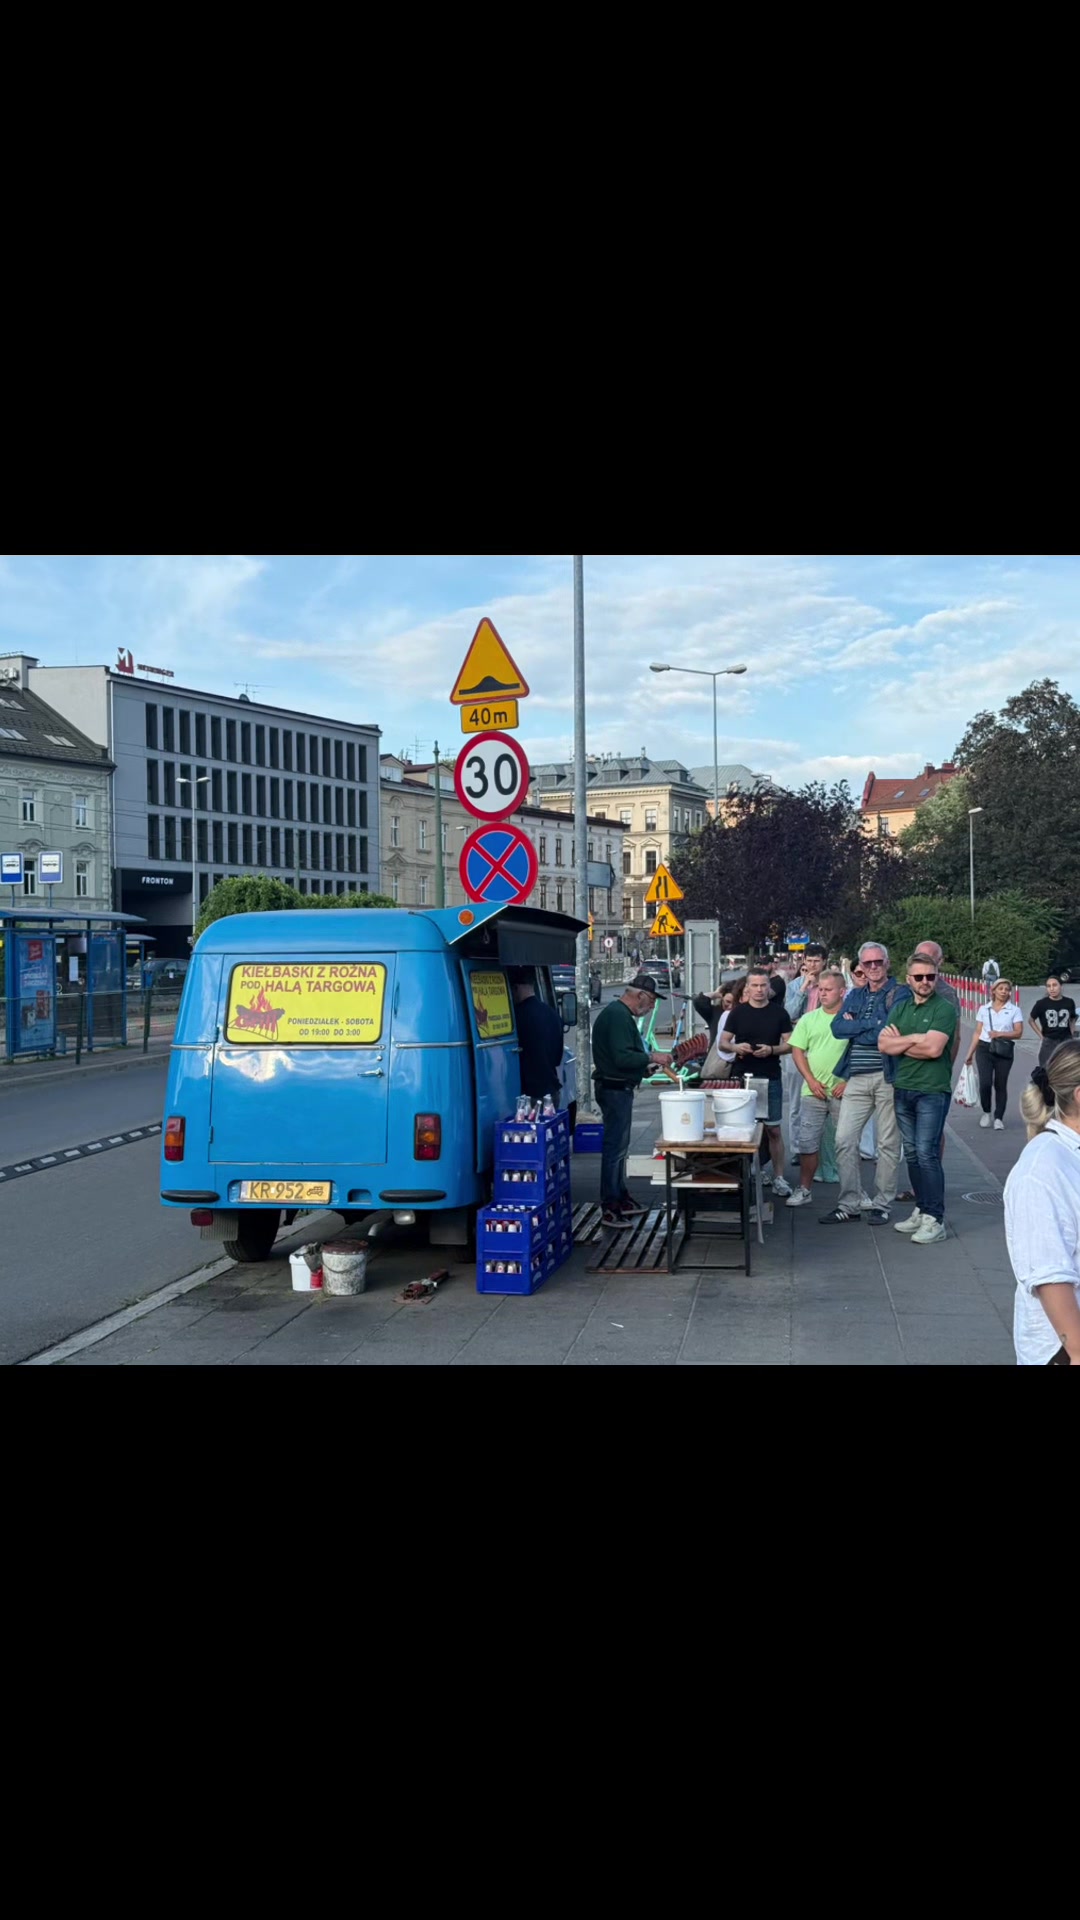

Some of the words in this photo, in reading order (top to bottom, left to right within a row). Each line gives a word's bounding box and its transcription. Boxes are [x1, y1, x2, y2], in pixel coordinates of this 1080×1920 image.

[465, 753, 518, 799] 30
[141, 876, 174, 885] FRONTON
[241, 966, 314, 978] KIEŁBASKI
[316, 966, 326, 978] Z
[240, 981, 261, 990] POD
[265, 980, 302, 995] HALĄ
[306, 980, 376, 995] TARGOWĄ
[287, 1017, 340, 1025] PONIEDZIAŁEK
[345, 1017, 374, 1025] SOBOTA
[1045, 1008, 1070, 1028] 82
[299, 1028, 309, 1036] OD
[311, 1028, 330, 1036] 19:00
[333, 1028, 344, 1036] DO
[346, 1028, 361, 1036] 3:00
[249, 1182, 271, 1199] KR
[275, 1182, 304, 1199] 952
